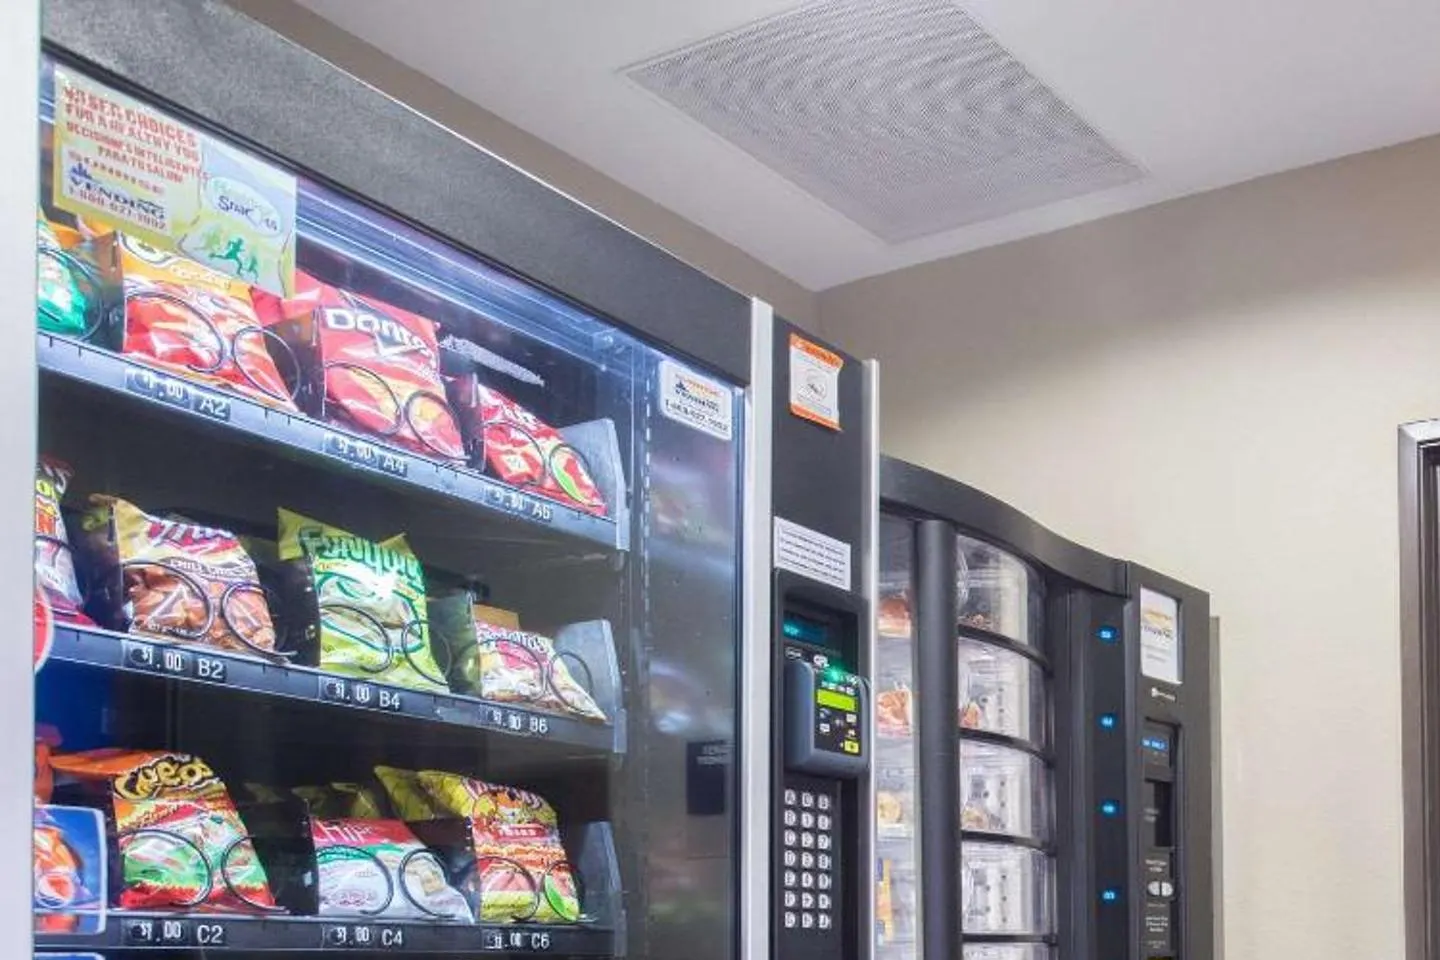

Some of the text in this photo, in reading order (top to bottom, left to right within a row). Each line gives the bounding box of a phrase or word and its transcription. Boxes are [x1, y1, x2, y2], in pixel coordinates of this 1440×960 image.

[200, 399, 227, 417] A2
[382, 453, 405, 473] A4
[532, 504, 551, 521] A6
[198, 659, 224, 679] B2
[379, 691, 401, 707] B4
[529, 720, 549, 734] B6
[197, 926, 225, 943] C2
[381, 929, 404, 945] C4
[531, 933, 551, 948] C6
